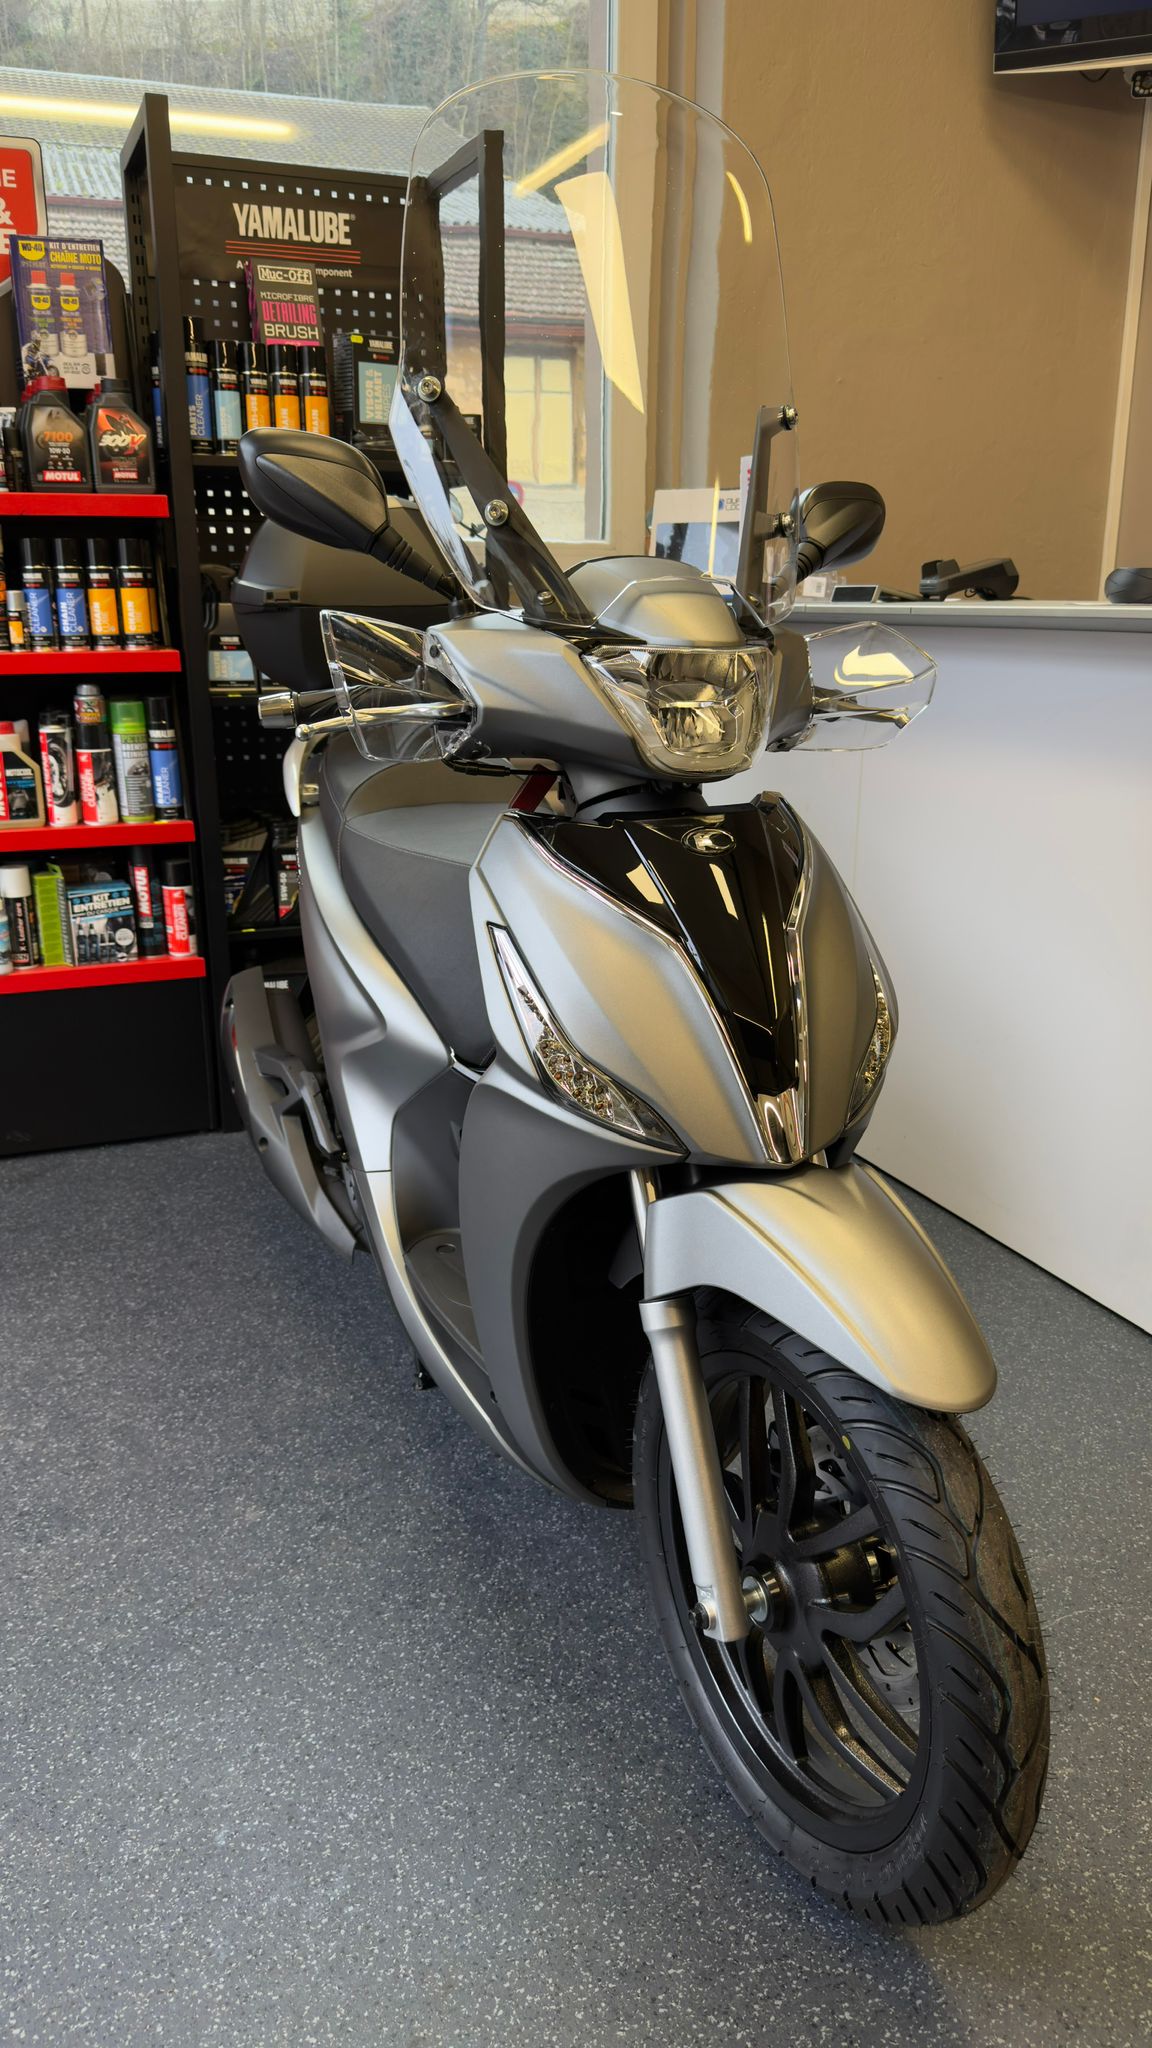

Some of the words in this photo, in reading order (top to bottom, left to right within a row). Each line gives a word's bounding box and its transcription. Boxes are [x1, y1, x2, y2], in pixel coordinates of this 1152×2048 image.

[0, 168, 17, 188] E
[232, 202, 352, 246] YAMALUBE
[20, 242, 42, 252] WD-40
[48, 242, 60, 250] KIT
[50, 249, 78, 264] CHAÎNE
[79, 253, 101, 265] MOTO
[260, 267, 309, 282] Muc-Off
[315, 267, 353, 279] mponent
[260, 291, 314, 304] MICROFIBRE
[261, 301, 317, 326] DETAILING
[264, 323, 319, 340] BRUSH
[366, 380, 375, 419] VISOR
[374, 371, 383, 419] HELMET
[189, 405, 199, 436] PARTS
[194, 394, 206, 437] CLEANER
[44, 431, 73, 443] 7100
[44, 472, 80, 481] MOTUL
[29, 592, 41, 633] CLEANER
[60, 602, 70, 633] CHAIN
[66, 592, 78, 633] CLEANER
[93, 601, 103, 633] CHAIN
[127, 601, 137, 632] CHAIN
[84, 767, 97, 808] CLEANER
[92, 893, 110, 903] KIT
[135, 869, 151, 914] MOTUL
[73, 897, 131, 913] ENTRETIEN
